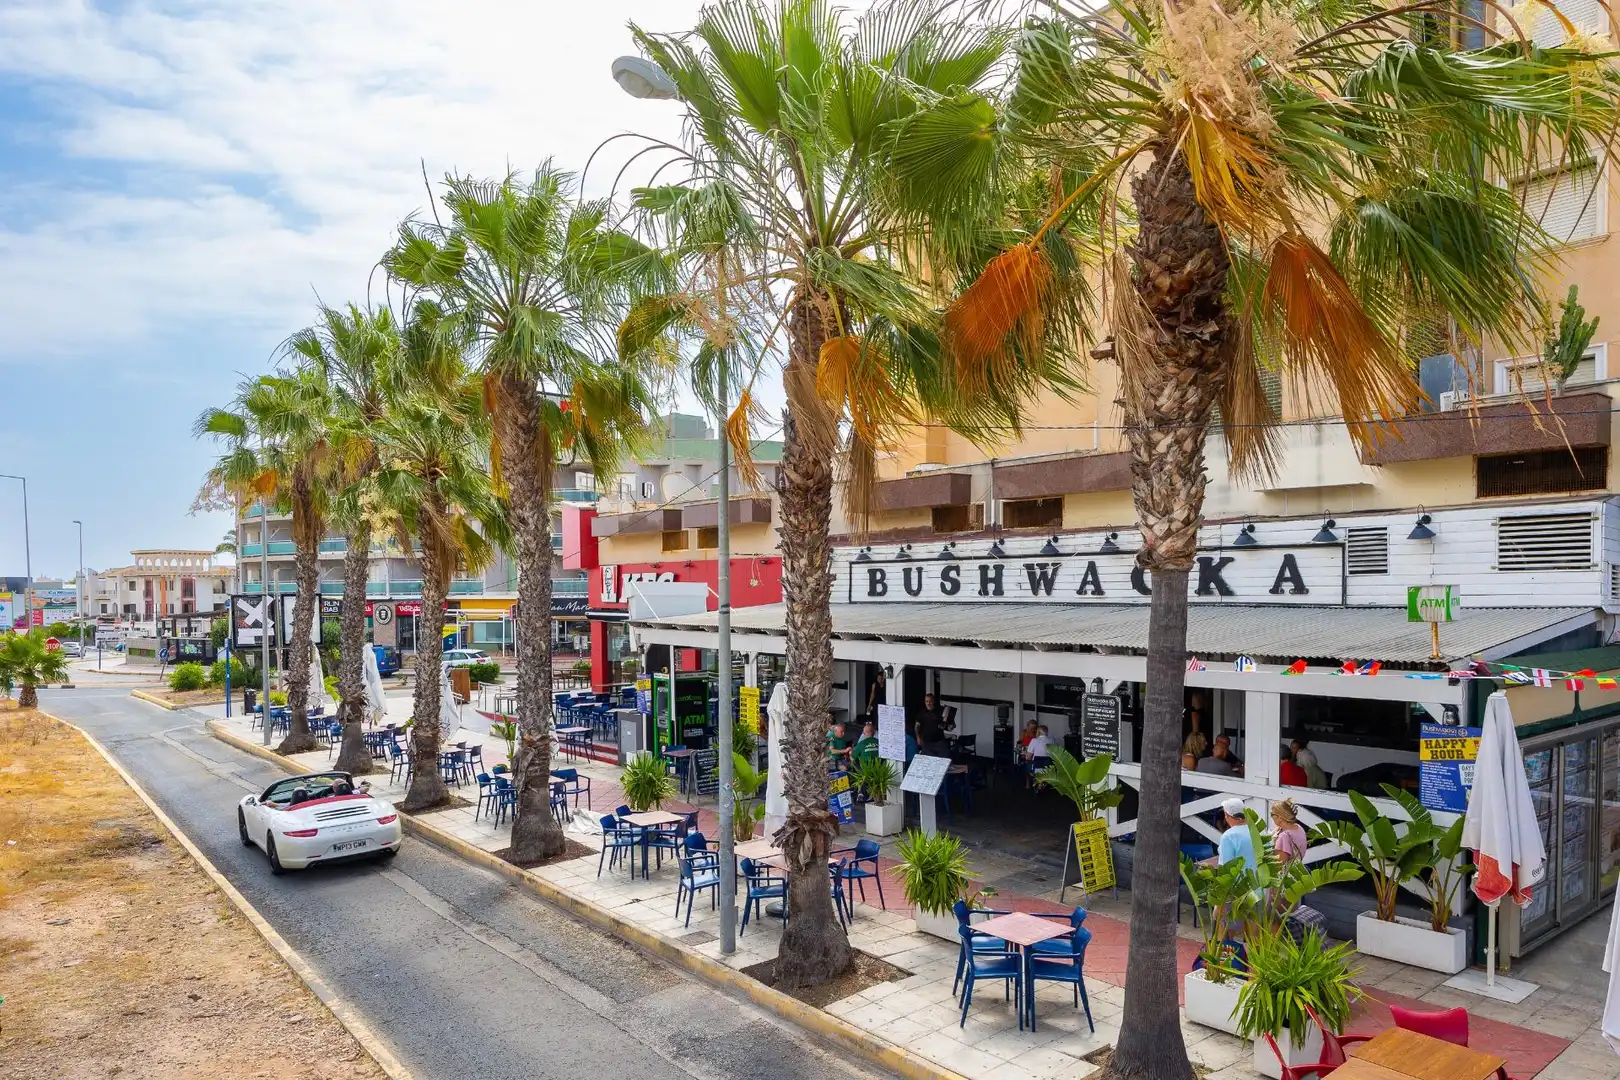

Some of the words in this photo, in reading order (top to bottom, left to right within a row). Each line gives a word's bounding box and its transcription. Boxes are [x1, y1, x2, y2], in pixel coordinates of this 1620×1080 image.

[1420, 599, 1445, 608] ATM
[684, 715, 705, 725] ATM
[1424, 739, 1467, 749] HAPPY
[1430, 749, 1465, 759] HOUR
